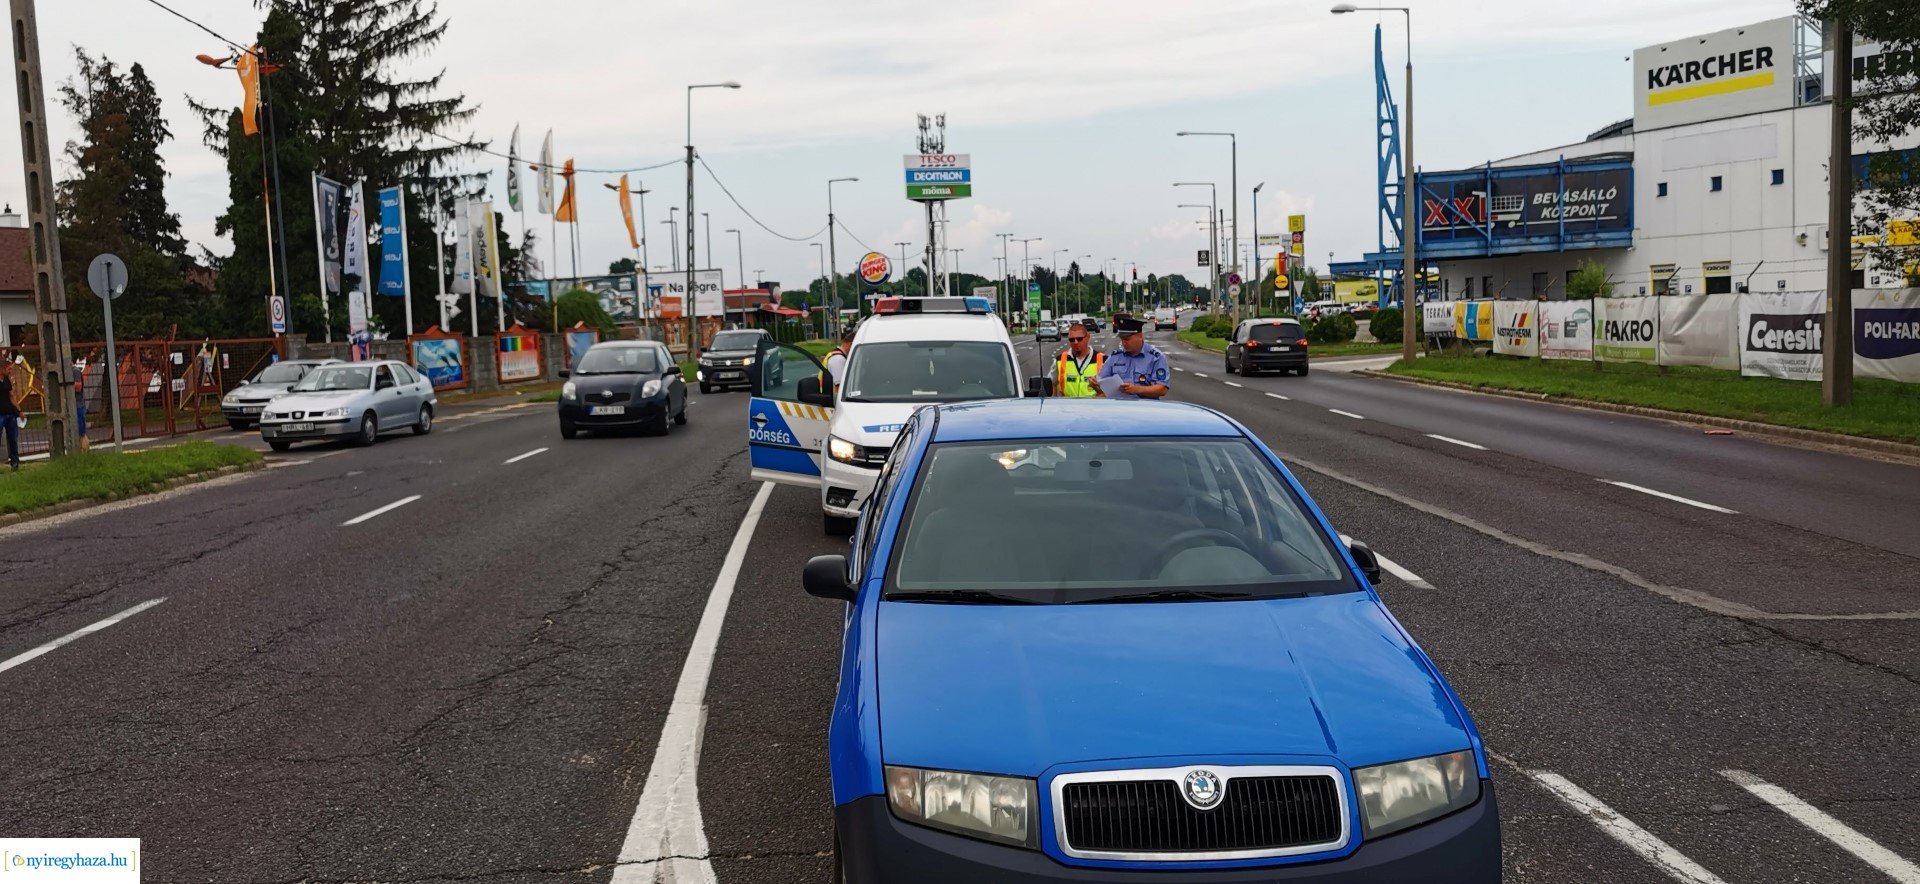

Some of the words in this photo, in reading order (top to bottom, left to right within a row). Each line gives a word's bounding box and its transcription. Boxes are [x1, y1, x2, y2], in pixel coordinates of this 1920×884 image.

[1648, 46, 1774, 89] KÄRCHER
[920, 155, 956, 163] TESCO
[914, 171, 963, 181] DECATHLON
[1532, 185, 1617, 205] BEVÁSÁRLÓ
[1540, 203, 1610, 220] KÖZPONT
[862, 257, 885, 270] BURGER
[863, 263, 887, 278] KING
[669, 283, 684, 293] Na
[1497, 326, 1532, 338] USTROTHERM
[1605, 319, 1654, 342] FAKRO
[1750, 319, 1822, 350] Ceresit
